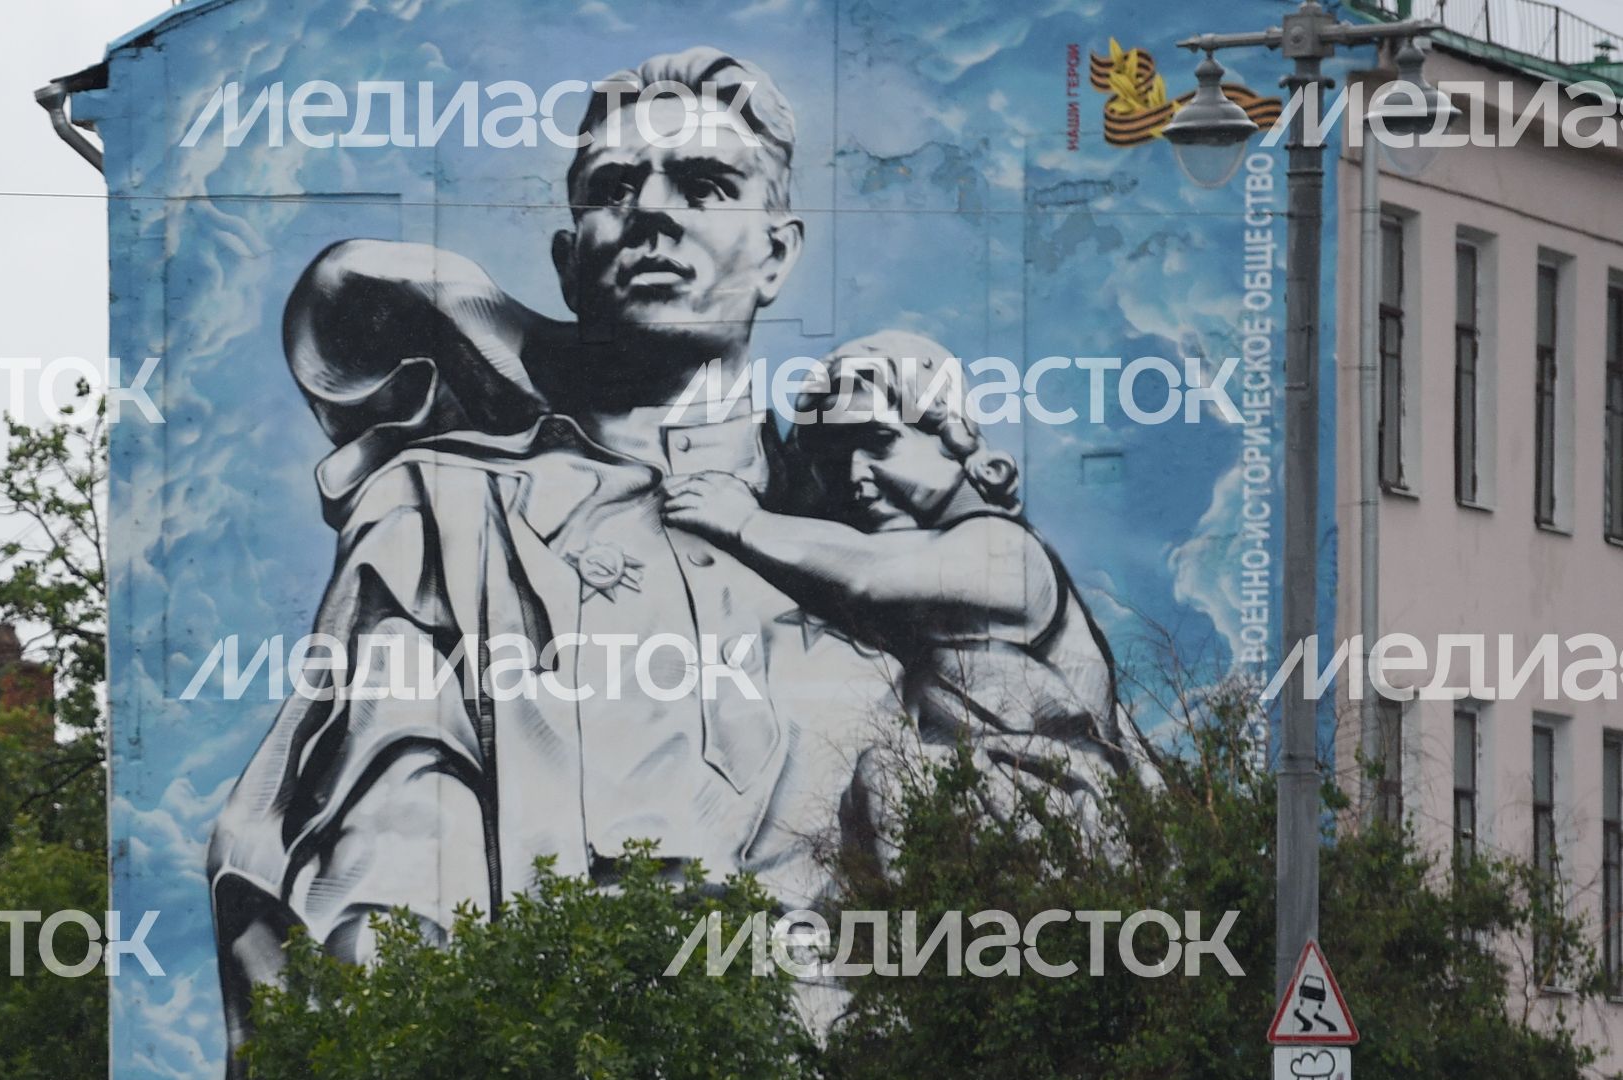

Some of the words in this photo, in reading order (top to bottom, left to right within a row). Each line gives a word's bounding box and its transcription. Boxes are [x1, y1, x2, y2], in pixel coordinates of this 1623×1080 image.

[1066, 43, 1080, 97] ГЕРОИ
[1066, 101, 1080, 151] НАШИ
[1244, 152, 1274, 311] ОБЩЕСТВО
[1241, 318, 1273, 663] ВОЕННО-ИСТОРИЧЕСКОЕ
